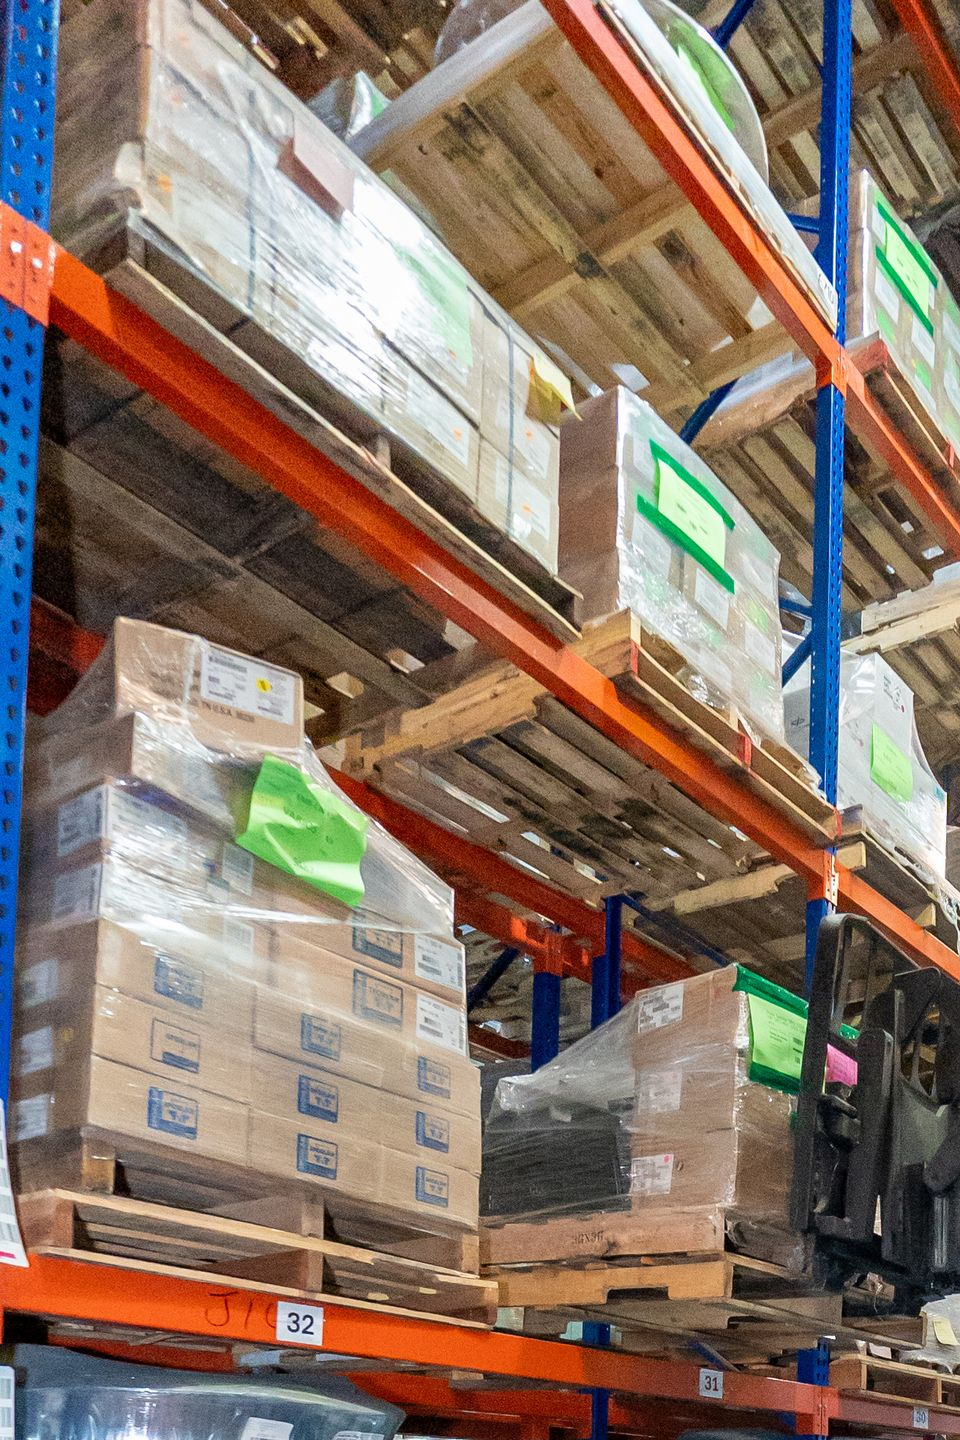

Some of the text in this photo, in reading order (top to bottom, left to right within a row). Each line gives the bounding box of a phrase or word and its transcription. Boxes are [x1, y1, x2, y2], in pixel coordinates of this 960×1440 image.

[286, 1311, 315, 1336] 32
[704, 1375, 719, 1392] 31
[915, 1410, 926, 1424] 30
